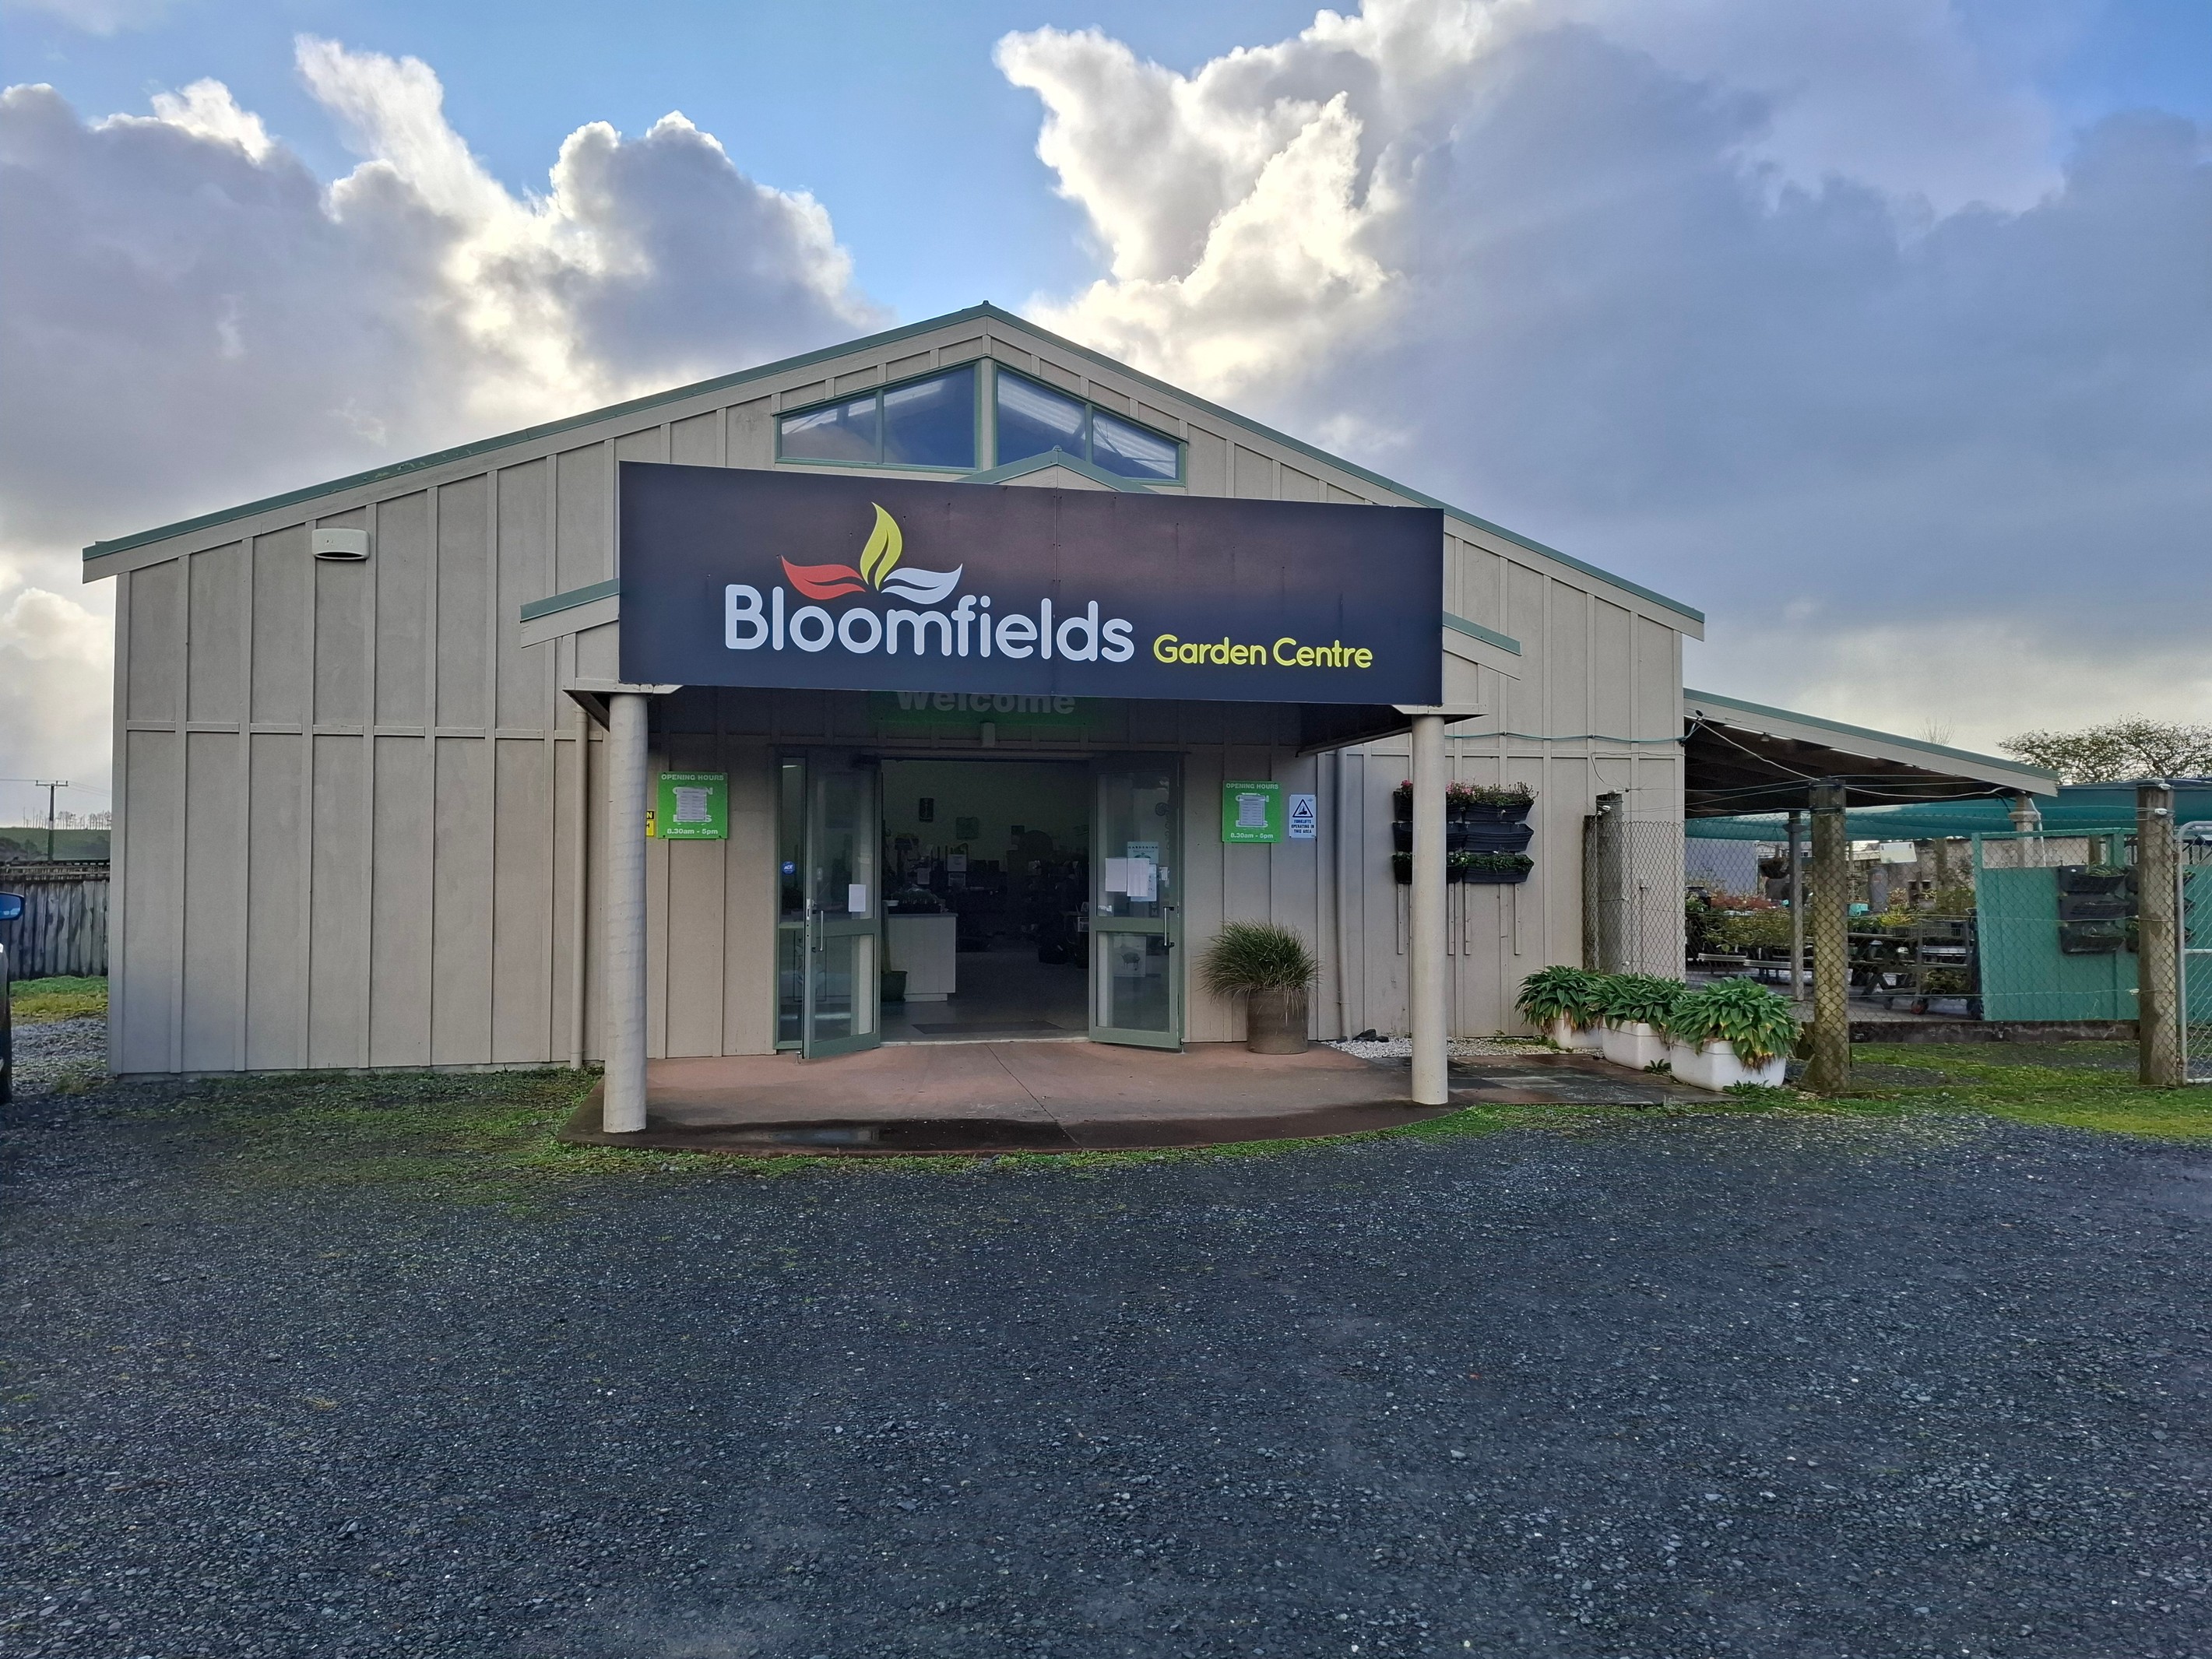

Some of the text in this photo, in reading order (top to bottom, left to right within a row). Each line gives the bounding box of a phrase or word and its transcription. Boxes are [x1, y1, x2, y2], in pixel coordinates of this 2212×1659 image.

[725, 584, 1134, 663] Bloomfields
[1153, 634, 1373, 669] Garden Centre
[896, 691, 1076, 715] Welcome
